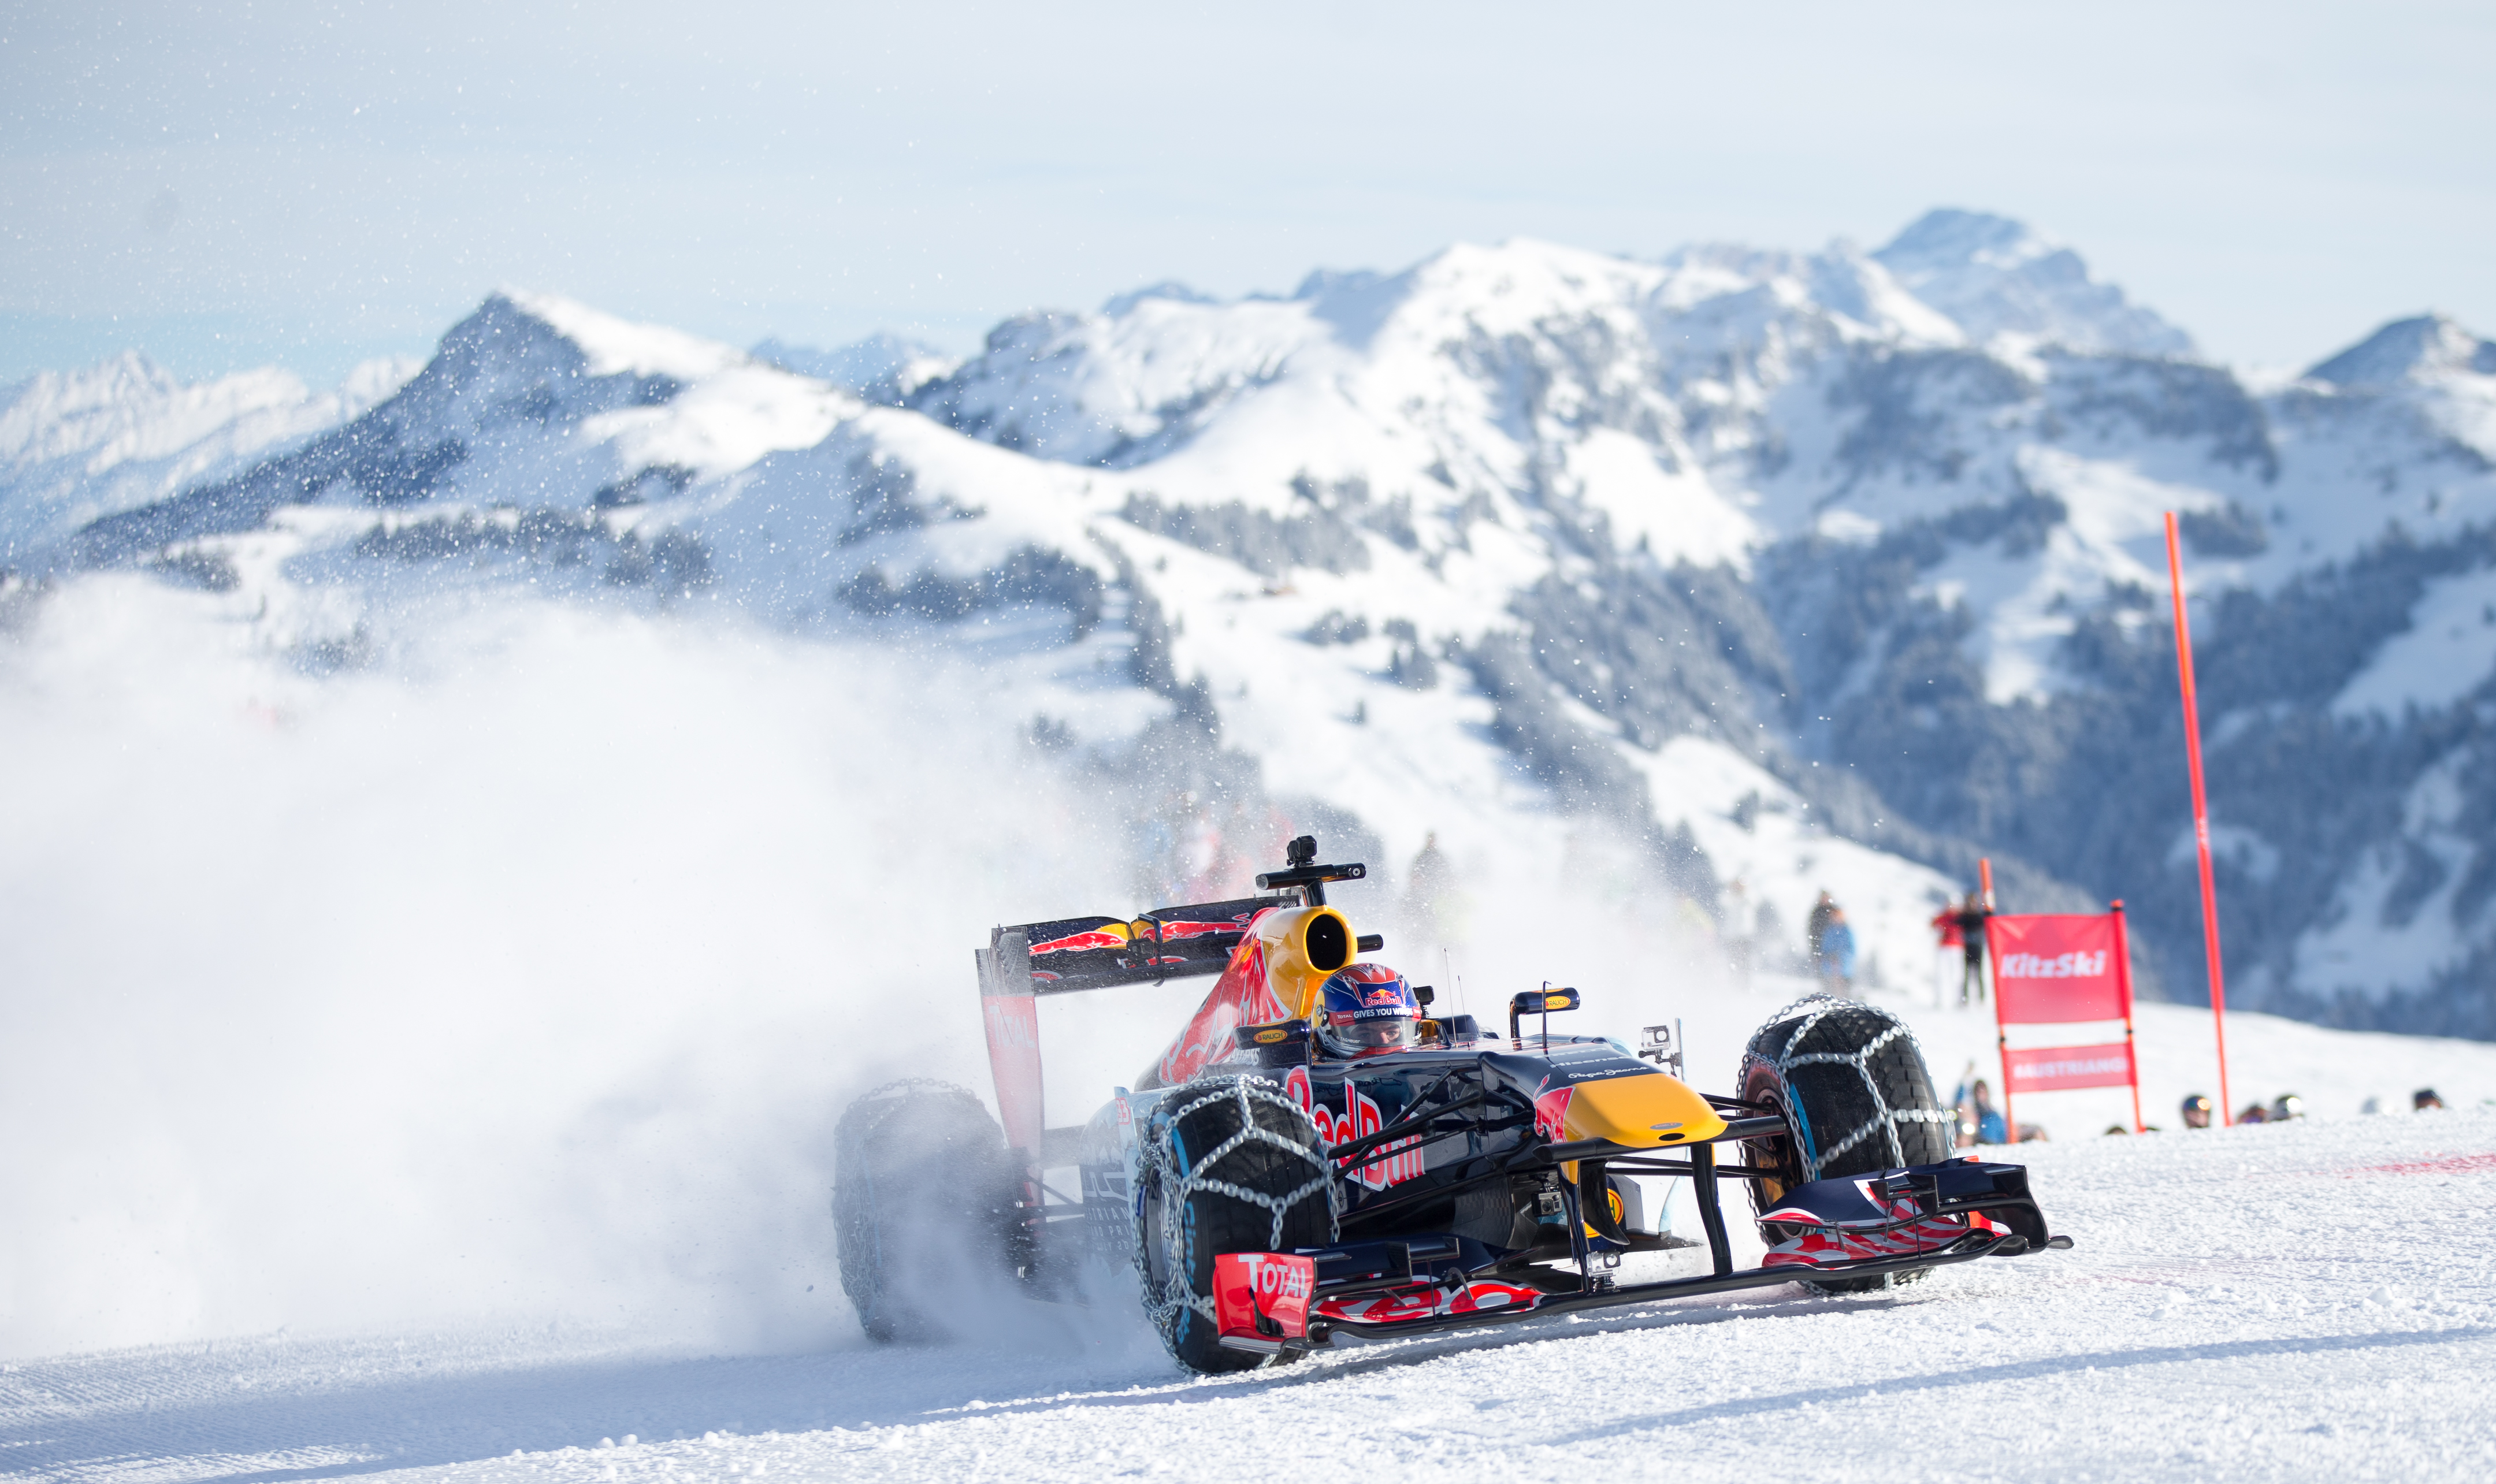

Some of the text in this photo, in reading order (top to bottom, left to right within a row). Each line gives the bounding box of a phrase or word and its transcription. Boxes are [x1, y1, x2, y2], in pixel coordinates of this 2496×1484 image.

[2000, 949, 2108, 979] KitzSki
[1365, 995, 1402, 1006] Red Bull
[1353, 1009, 1375, 1018] GIVES
[1375, 1008, 1392, 1016] YOU
[988, 1005, 1036, 1049] TOTAL
[1262, 1032, 1283, 1040] RAUCH
[1550, 1055, 1633, 1068] Hisense
[1568, 1066, 1649, 1078] Pepe Jeans
[1238, 1254, 1310, 1299] TOTAL
